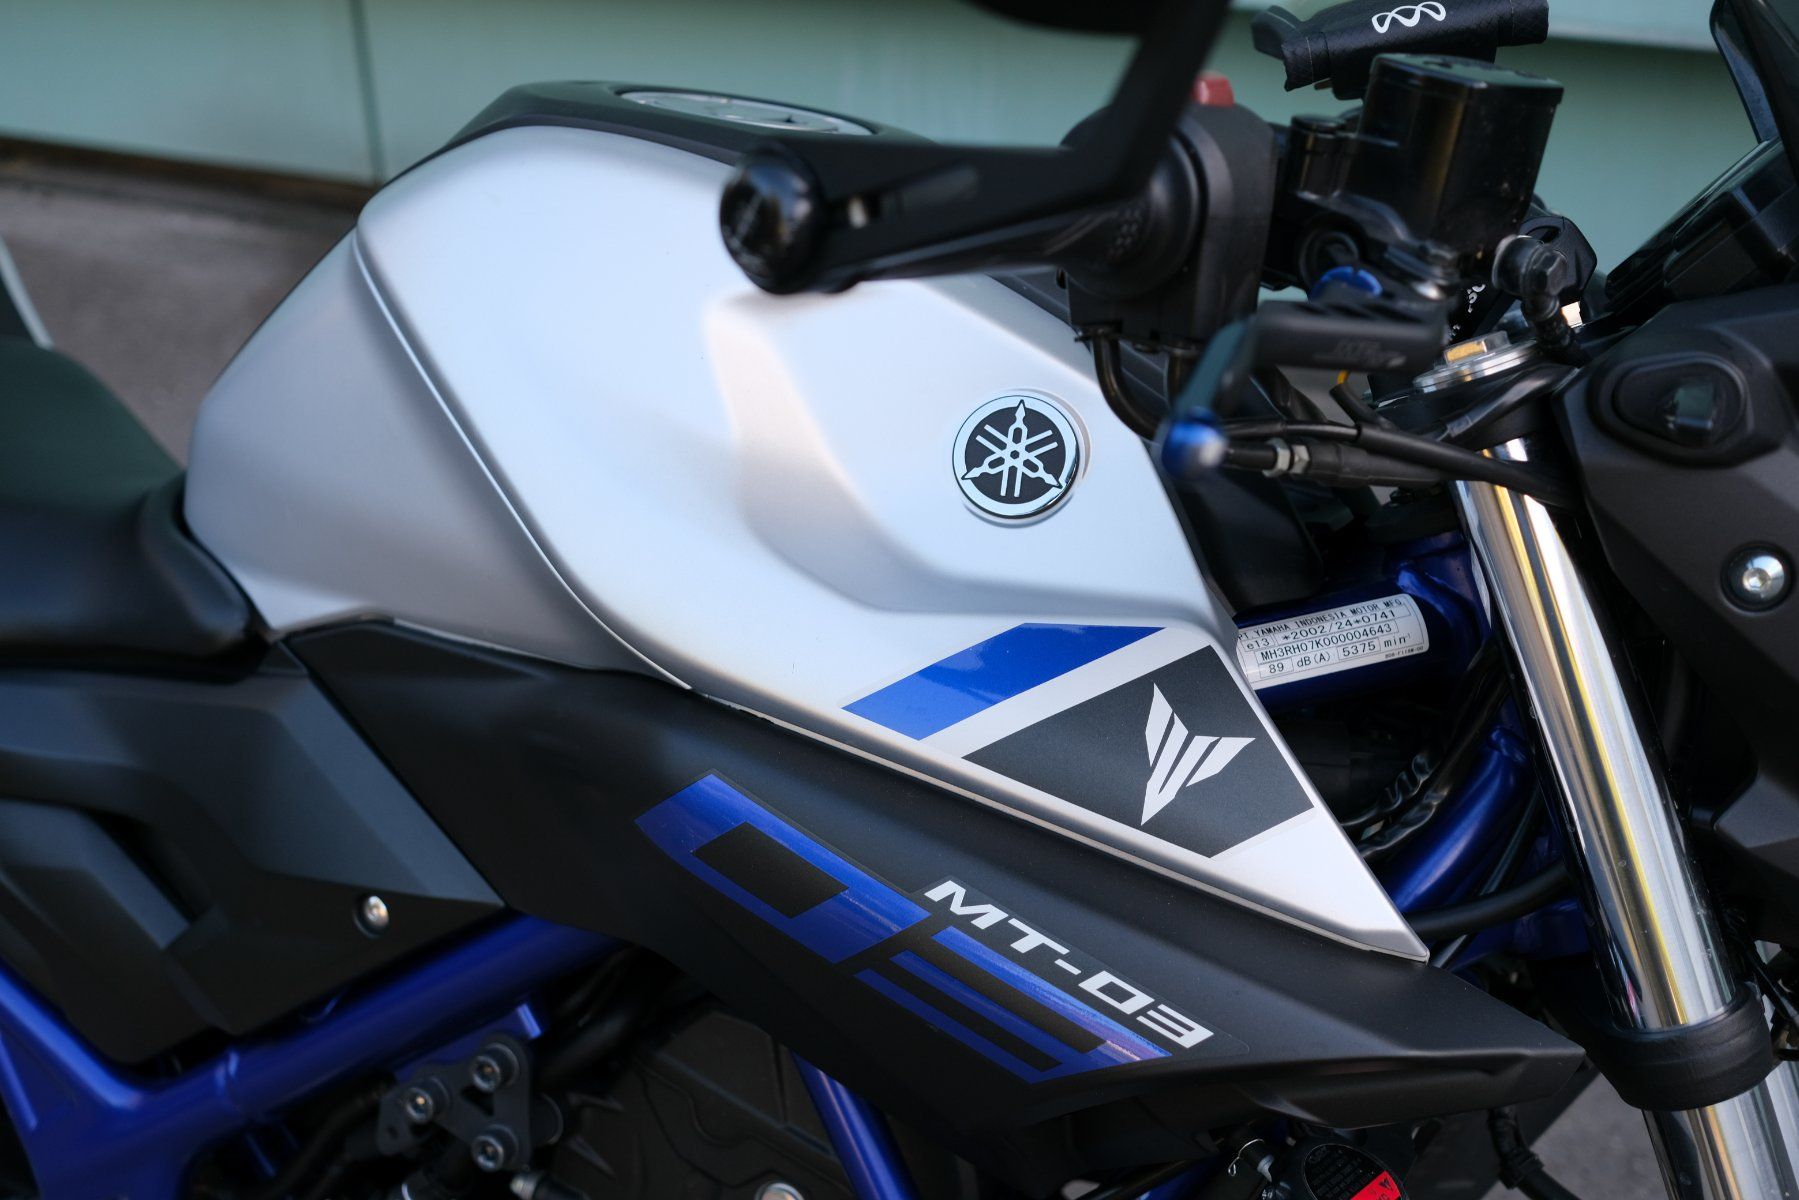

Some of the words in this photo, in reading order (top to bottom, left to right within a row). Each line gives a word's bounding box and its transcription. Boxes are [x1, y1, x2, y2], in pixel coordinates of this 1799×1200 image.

[1254, 623, 1290, 638] YAMAHA
[1295, 611, 1346, 629] INDONESIA
[1351, 603, 1379, 616] MOTOR
[1247, 638, 1270, 650] e13
[1269, 663, 1284, 673] 89
[1343, 641, 1376, 657] 5375
[924, 880, 1214, 1049] MT-03
